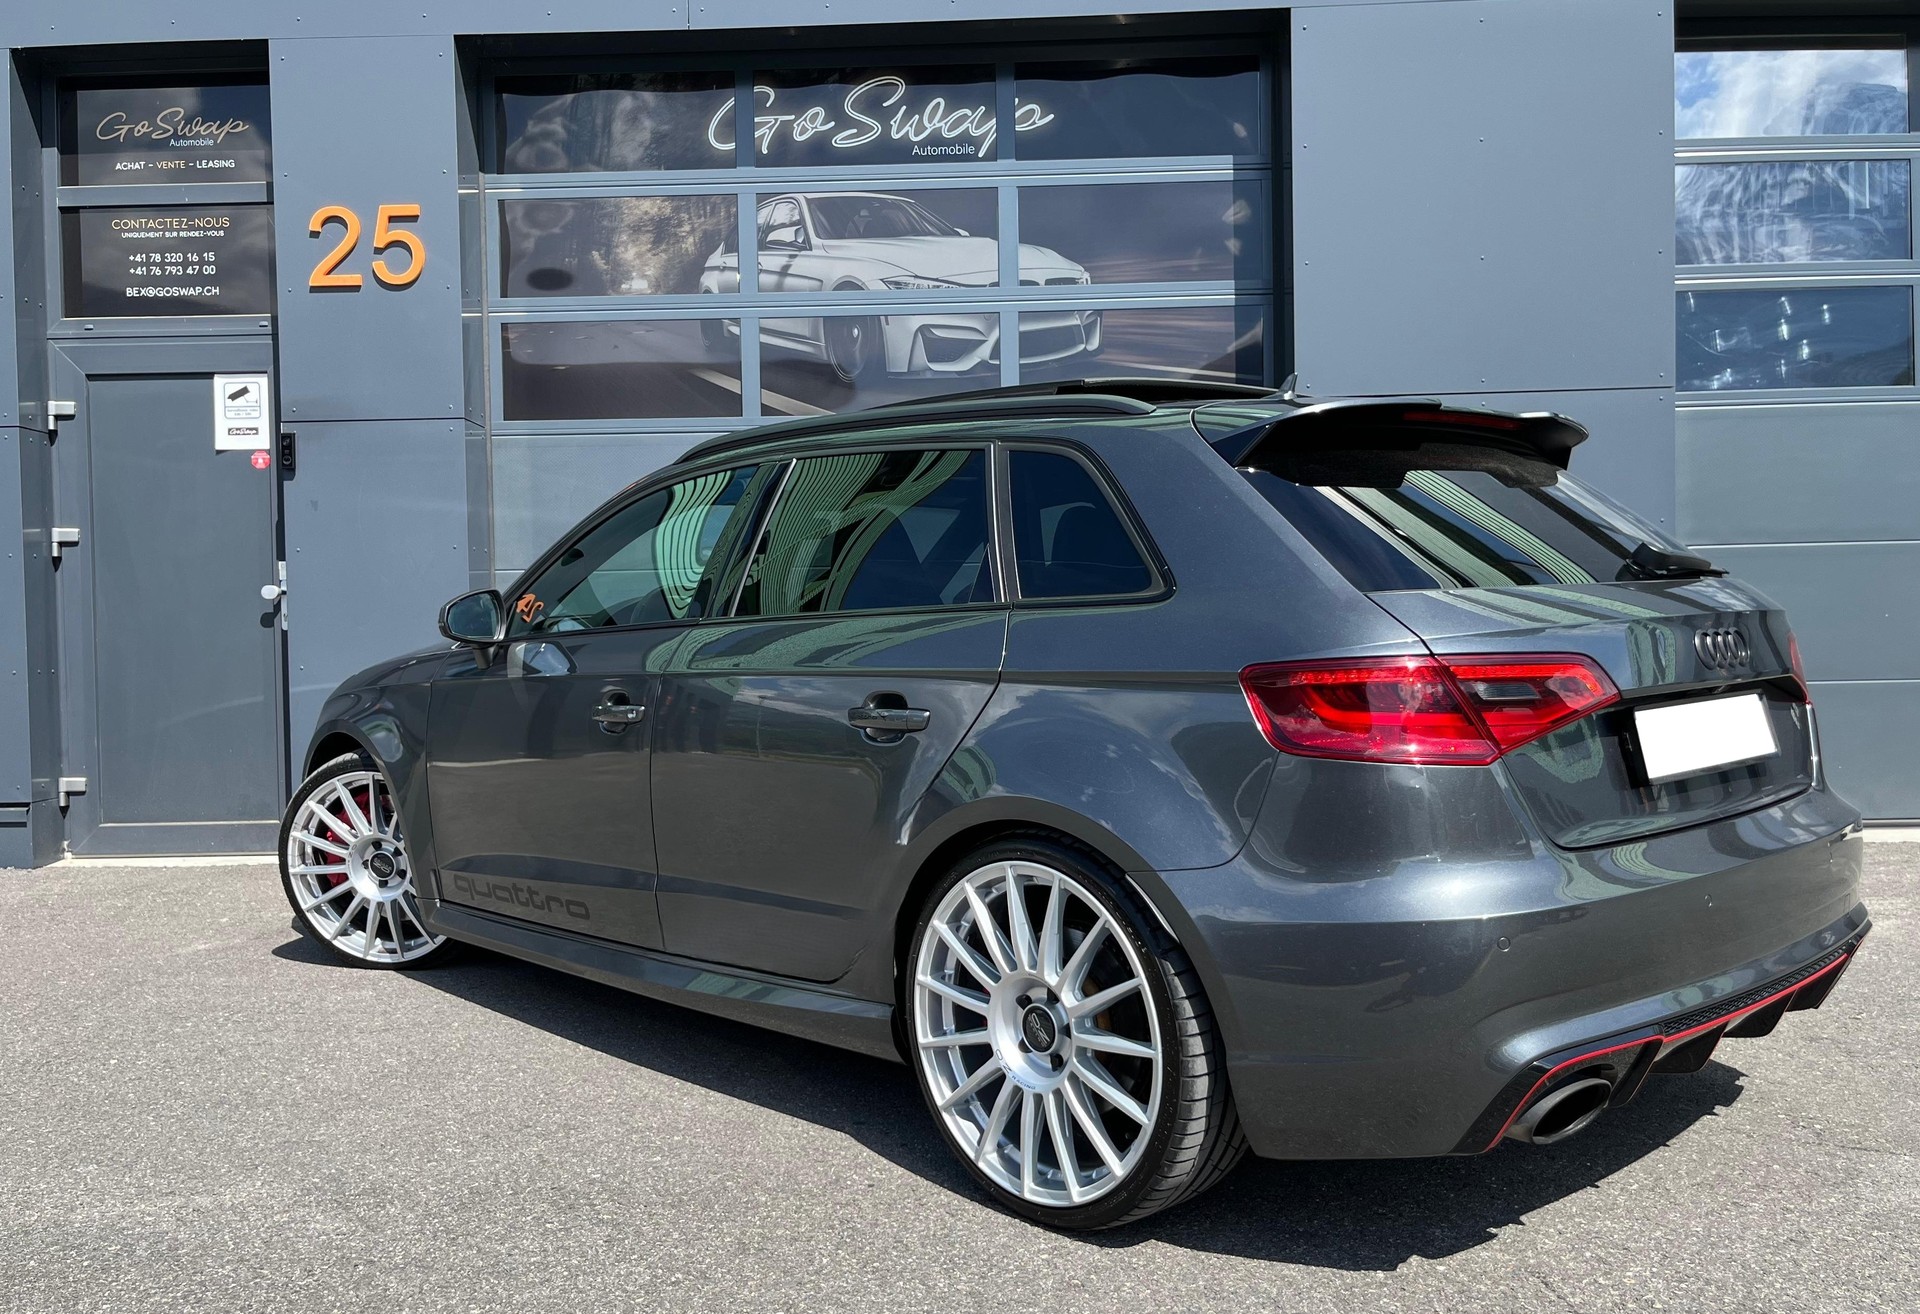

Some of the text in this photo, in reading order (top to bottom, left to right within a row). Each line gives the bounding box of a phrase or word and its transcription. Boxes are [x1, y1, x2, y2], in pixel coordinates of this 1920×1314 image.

[96, 107, 249, 143] GoSwap
[169, 138, 214, 147] Automobile
[911, 143, 975, 158] Automobile
[115, 161, 146, 171] ACHAT
[156, 160, 186, 169] VENTE
[196, 159, 235, 169] LEASING
[111, 217, 230, 230] CONTACTEZ-NOUS
[121, 231, 163, 239] UNIQUEMENT
[179, 230, 225, 238] RENDEZ-VOUS
[308, 204, 426, 288] 25
[128, 252, 216, 263] +41 78 320 16 15
[129, 265, 216, 276] +41 76 793 47 00
[126, 286, 220, 297] BEX@GOSWAP.CH
[453, 873, 591, 921] quattro
